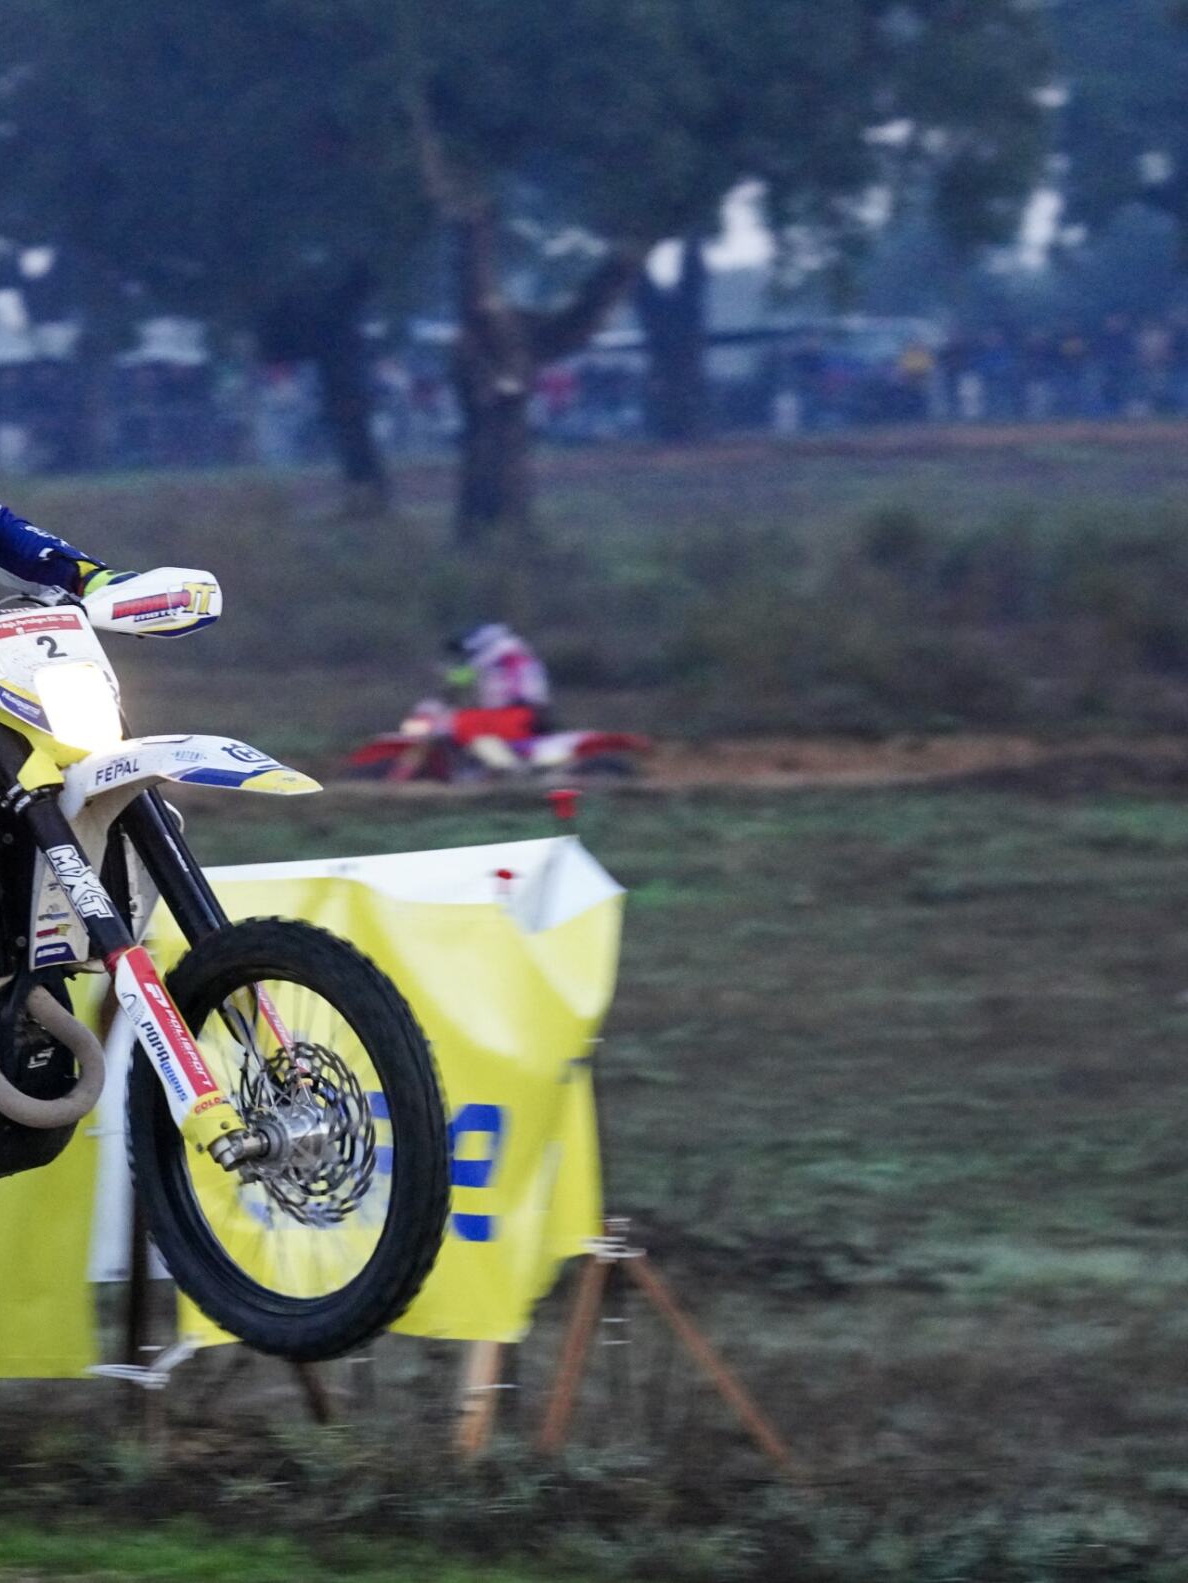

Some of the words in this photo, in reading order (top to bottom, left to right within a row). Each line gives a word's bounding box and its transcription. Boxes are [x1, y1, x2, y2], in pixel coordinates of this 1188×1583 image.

[36, 635, 68, 659] 2
[95, 758, 141, 786] FEPAL
[45, 844, 115, 919] MXT
